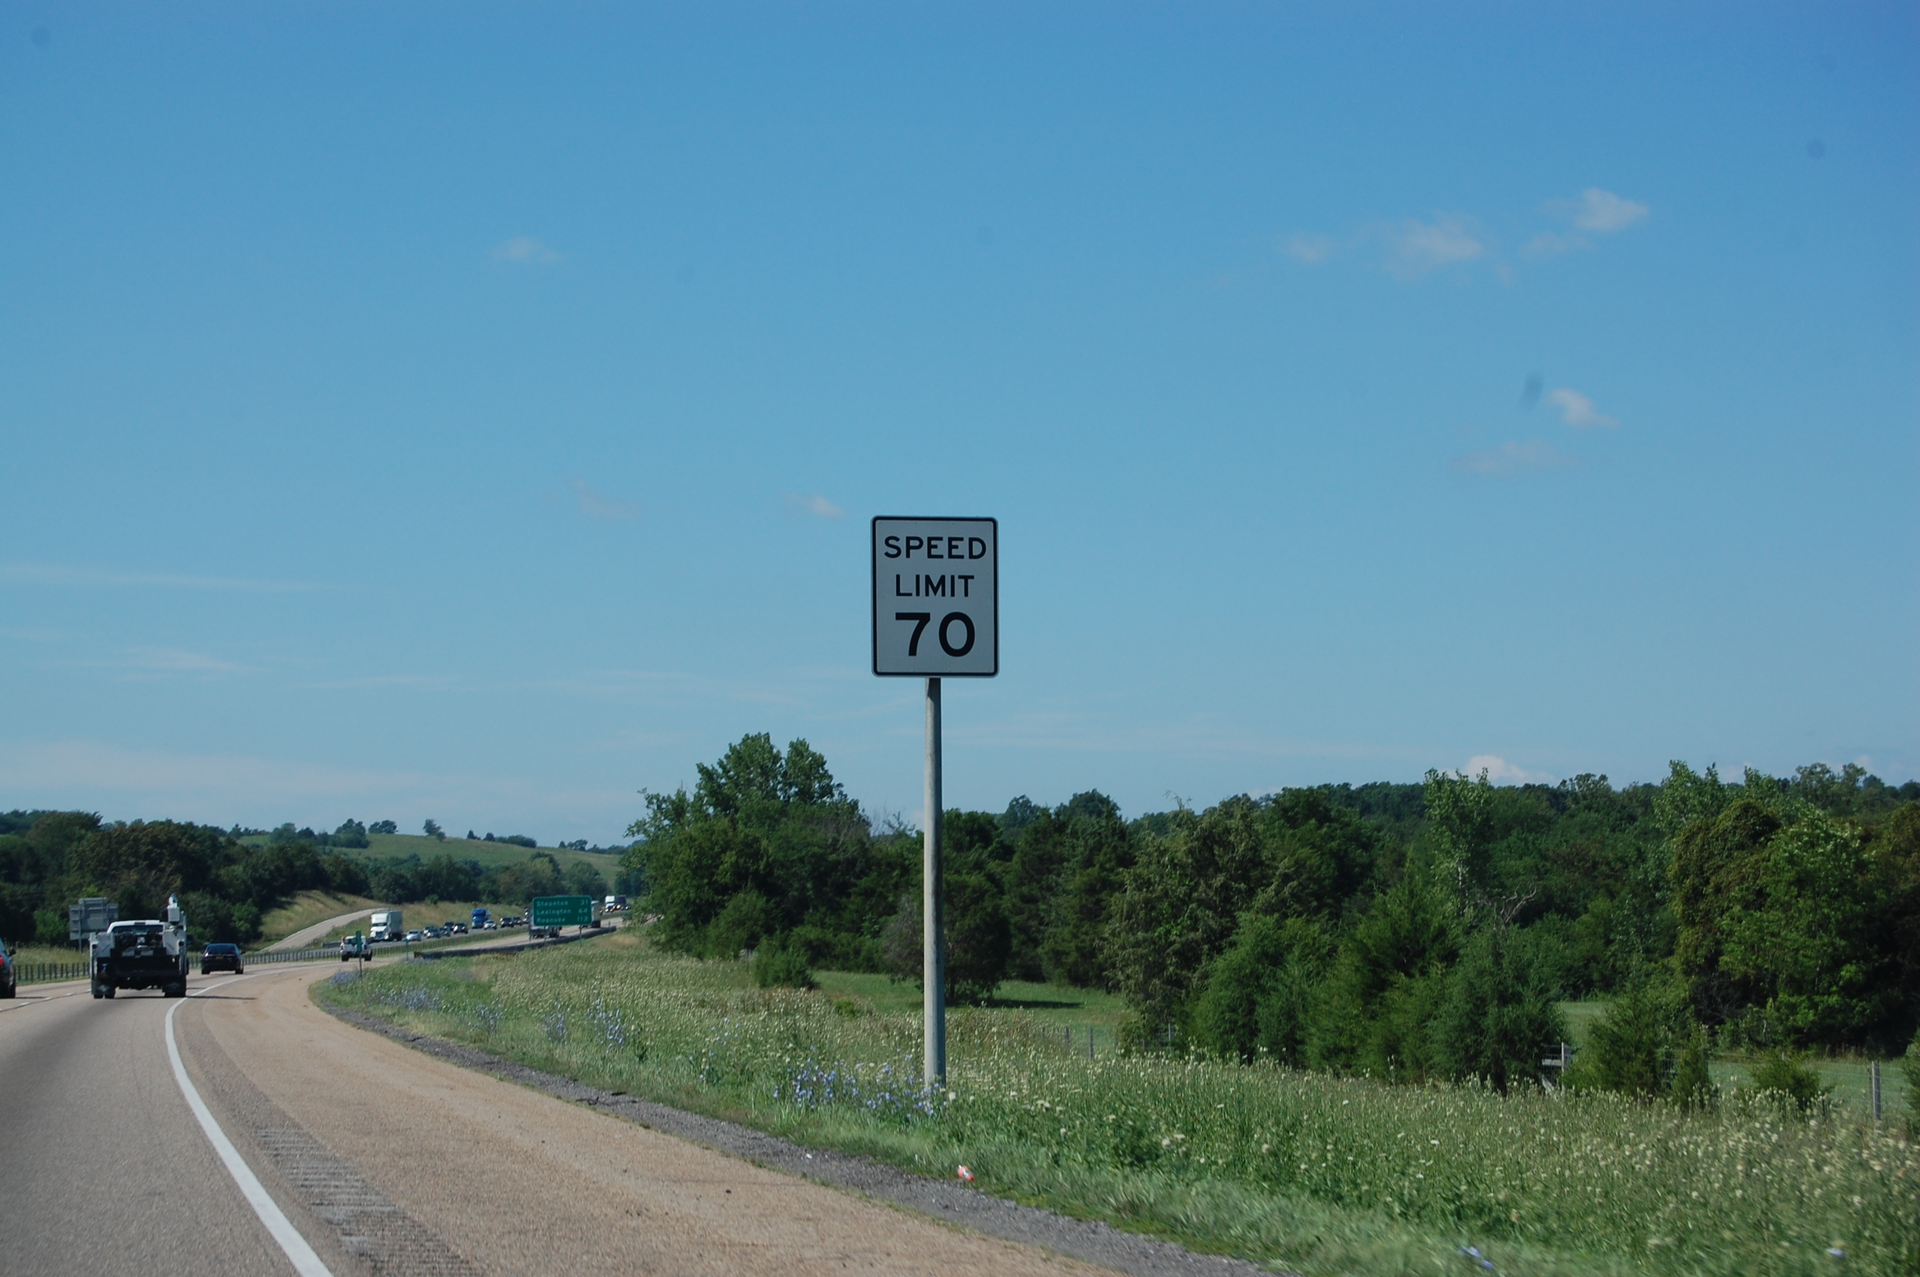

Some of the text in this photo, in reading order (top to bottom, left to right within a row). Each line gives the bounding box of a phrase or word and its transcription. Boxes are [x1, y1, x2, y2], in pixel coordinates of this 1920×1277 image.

[884, 535, 987, 559] SPEED
[895, 574, 975, 598] LIMIT
[895, 611, 975, 657] 70
[536, 908, 572, 916] Lexington
